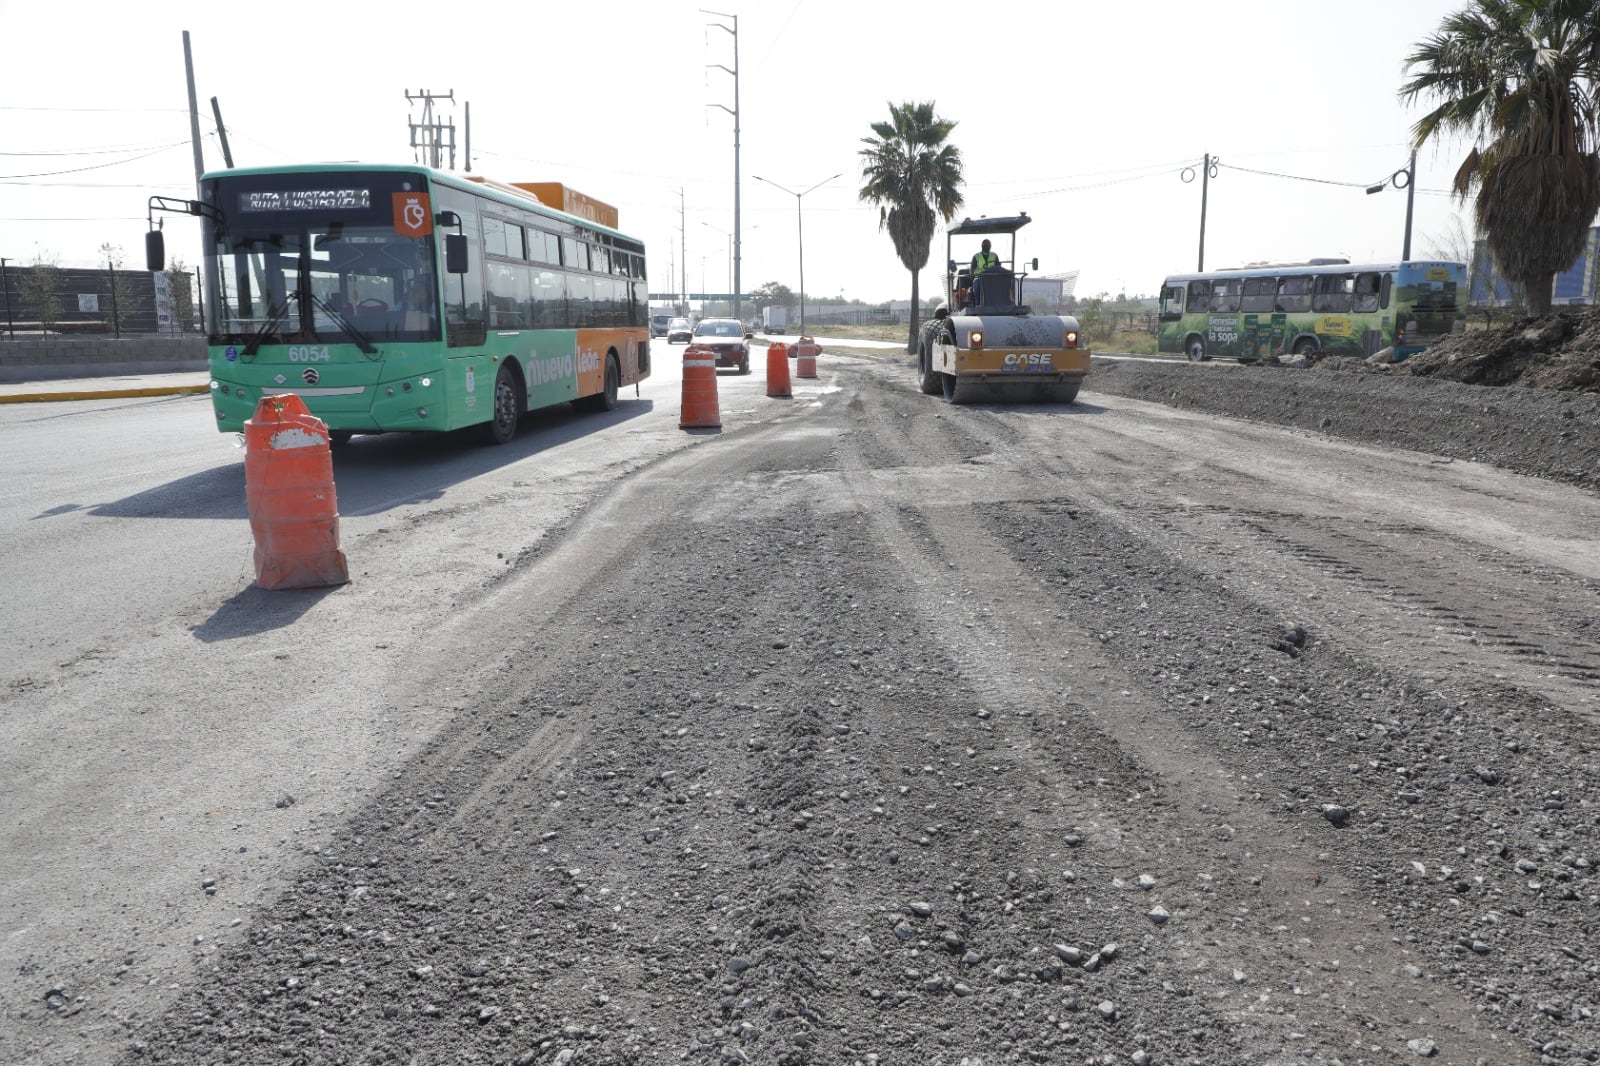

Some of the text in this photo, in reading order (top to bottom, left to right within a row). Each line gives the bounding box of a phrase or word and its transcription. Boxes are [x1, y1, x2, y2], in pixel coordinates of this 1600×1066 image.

[1208, 315, 1238, 325] Bienestar
[1208, 329, 1238, 344] la sopa
[289, 346, 330, 361] 6054
[576, 345, 599, 373] león
[1004, 353, 1052, 365] CASE
